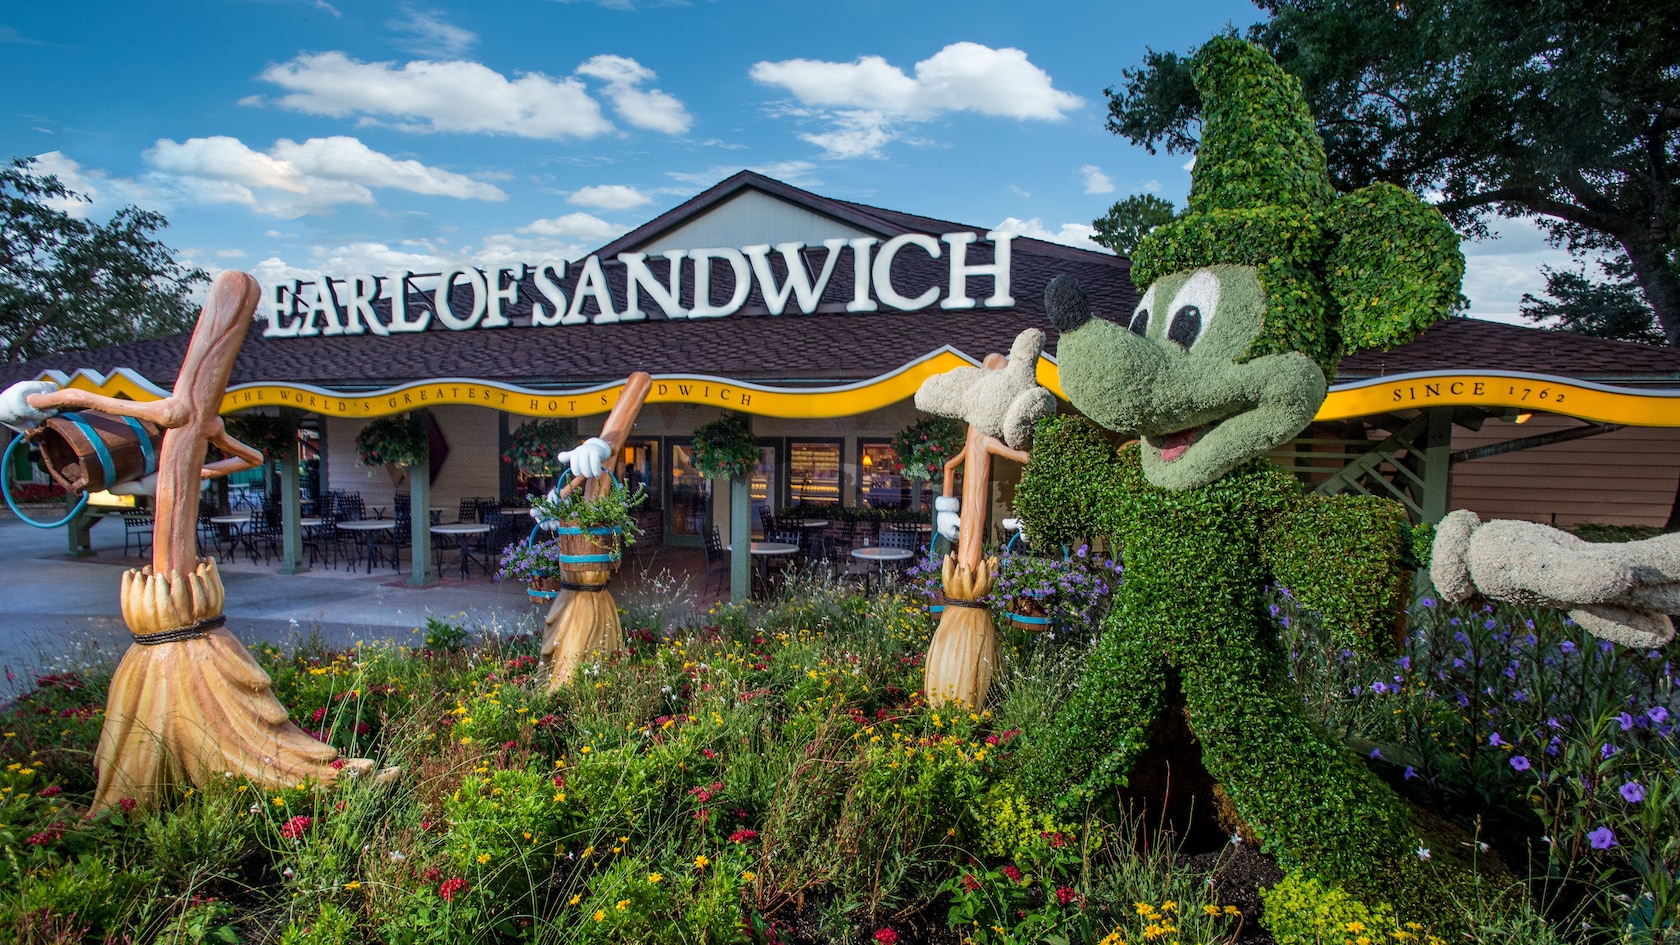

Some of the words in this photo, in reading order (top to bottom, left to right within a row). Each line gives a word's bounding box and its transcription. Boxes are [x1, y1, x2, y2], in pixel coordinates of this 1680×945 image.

[263, 270, 433, 338] EARL
[434, 262, 526, 331] OF
[531, 230, 1019, 328] SANDWICH
[231, 390, 264, 405] THE
[279, 390, 370, 412] WORLD'S
[389, 387, 509, 409] GREATEST
[529, 399, 577, 411] HOT
[600, 384, 752, 407] SDWICH
[1393, 382, 1485, 402] SINCE
[1508, 386, 1565, 403] 1762
